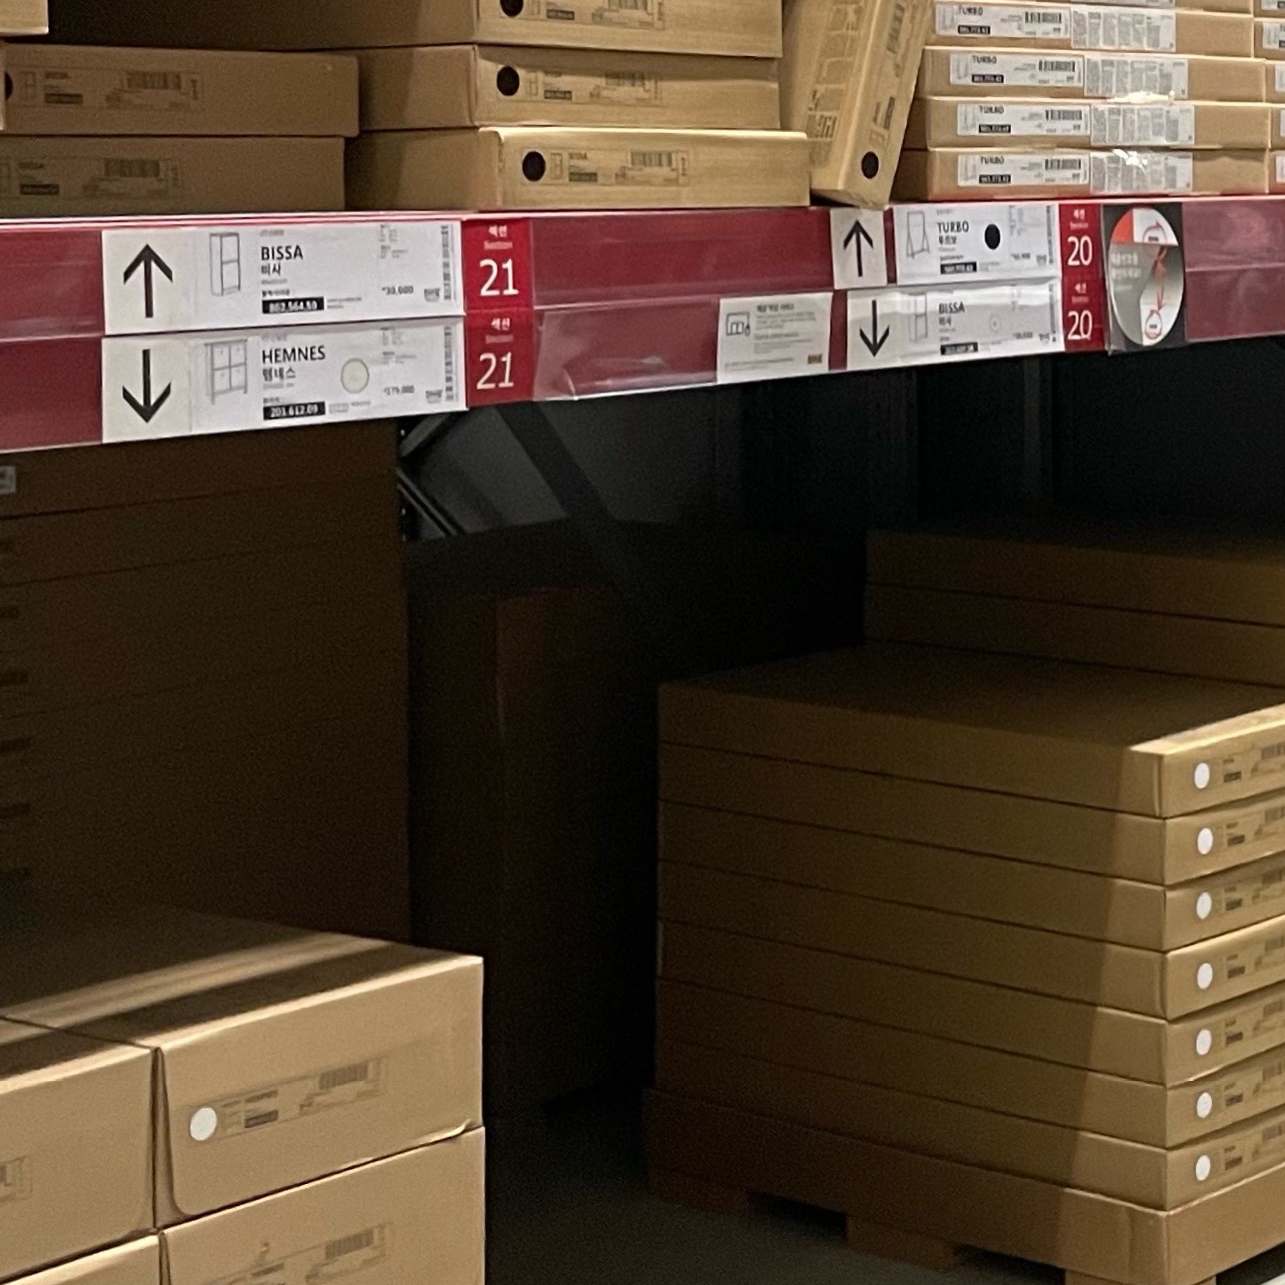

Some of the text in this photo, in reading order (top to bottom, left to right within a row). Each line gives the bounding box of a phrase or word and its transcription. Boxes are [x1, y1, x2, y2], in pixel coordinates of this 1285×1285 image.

[957, 5, 984, 16] TURBO
[972, 55, 998, 65] TURBO
[980, 155, 1006, 165] TURBO
[936, 220, 970, 234] TURBO
[261, 244, 304, 261] BISSA
[1067, 235, 1093, 266] 20
[479, 258, 519, 296] 21
[1067, 309, 1093, 341] 20
[262, 345, 326, 364] HEMNES
[476, 351, 514, 390] 21
